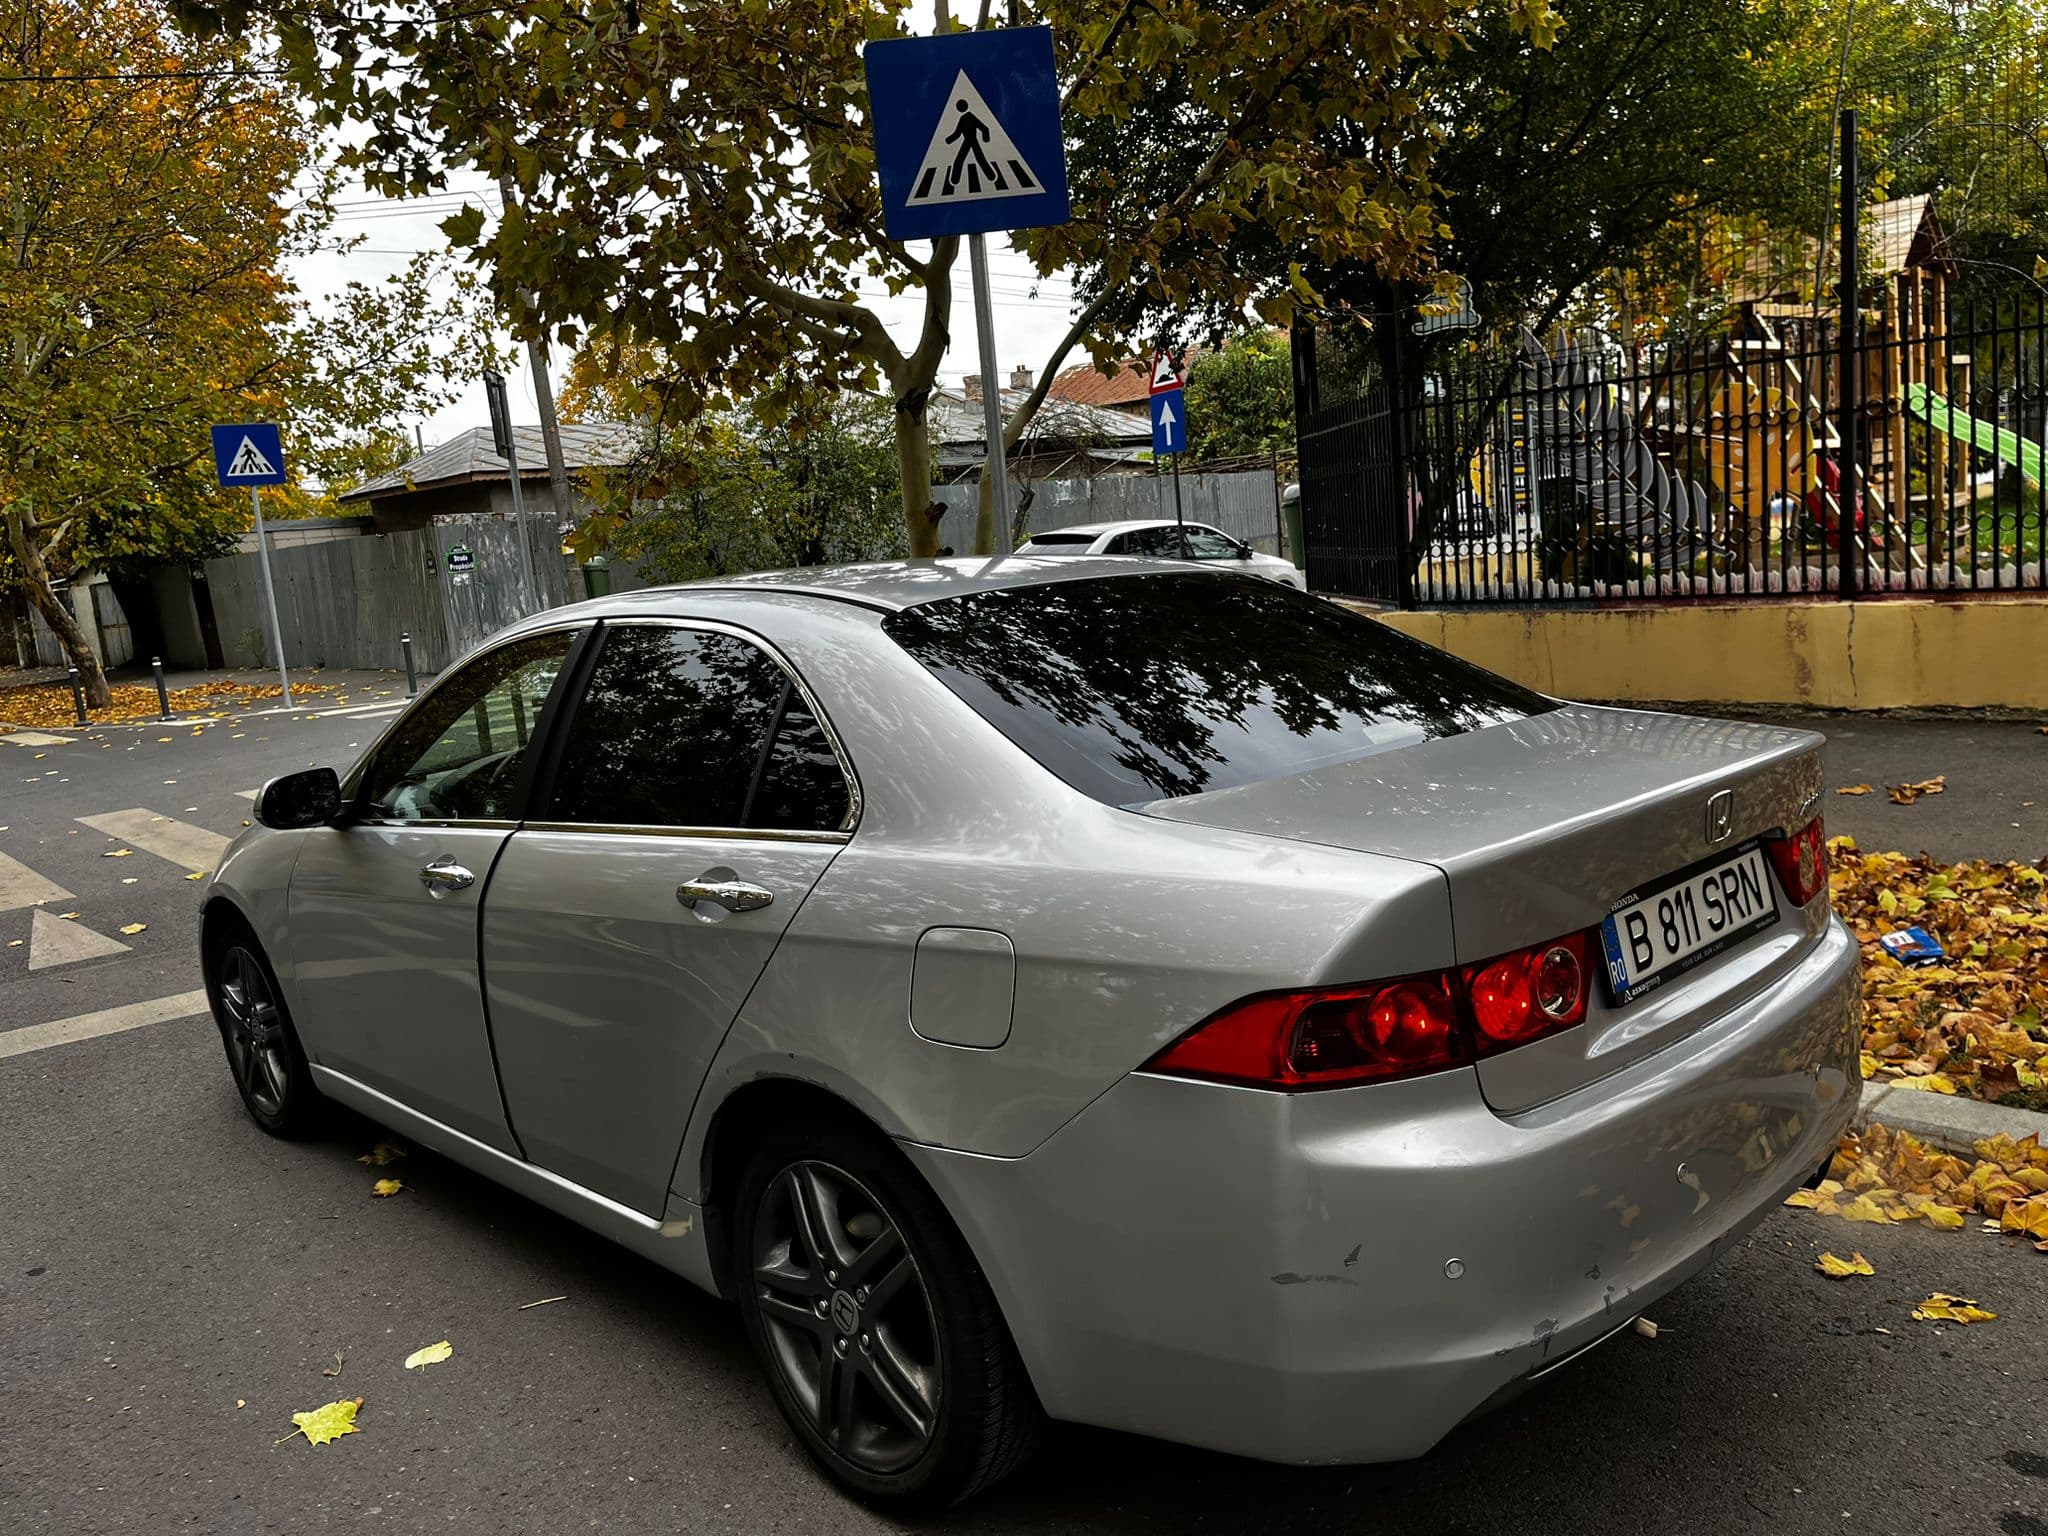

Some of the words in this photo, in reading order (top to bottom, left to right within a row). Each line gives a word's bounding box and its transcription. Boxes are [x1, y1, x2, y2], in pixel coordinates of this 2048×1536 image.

[1611, 893, 1639, 912] HONDA
[1624, 910, 1653, 974] B
[1658, 885, 1701, 954] 811
[1702, 857, 1764, 932] SRN
[1610, 958, 1626, 985] RO
